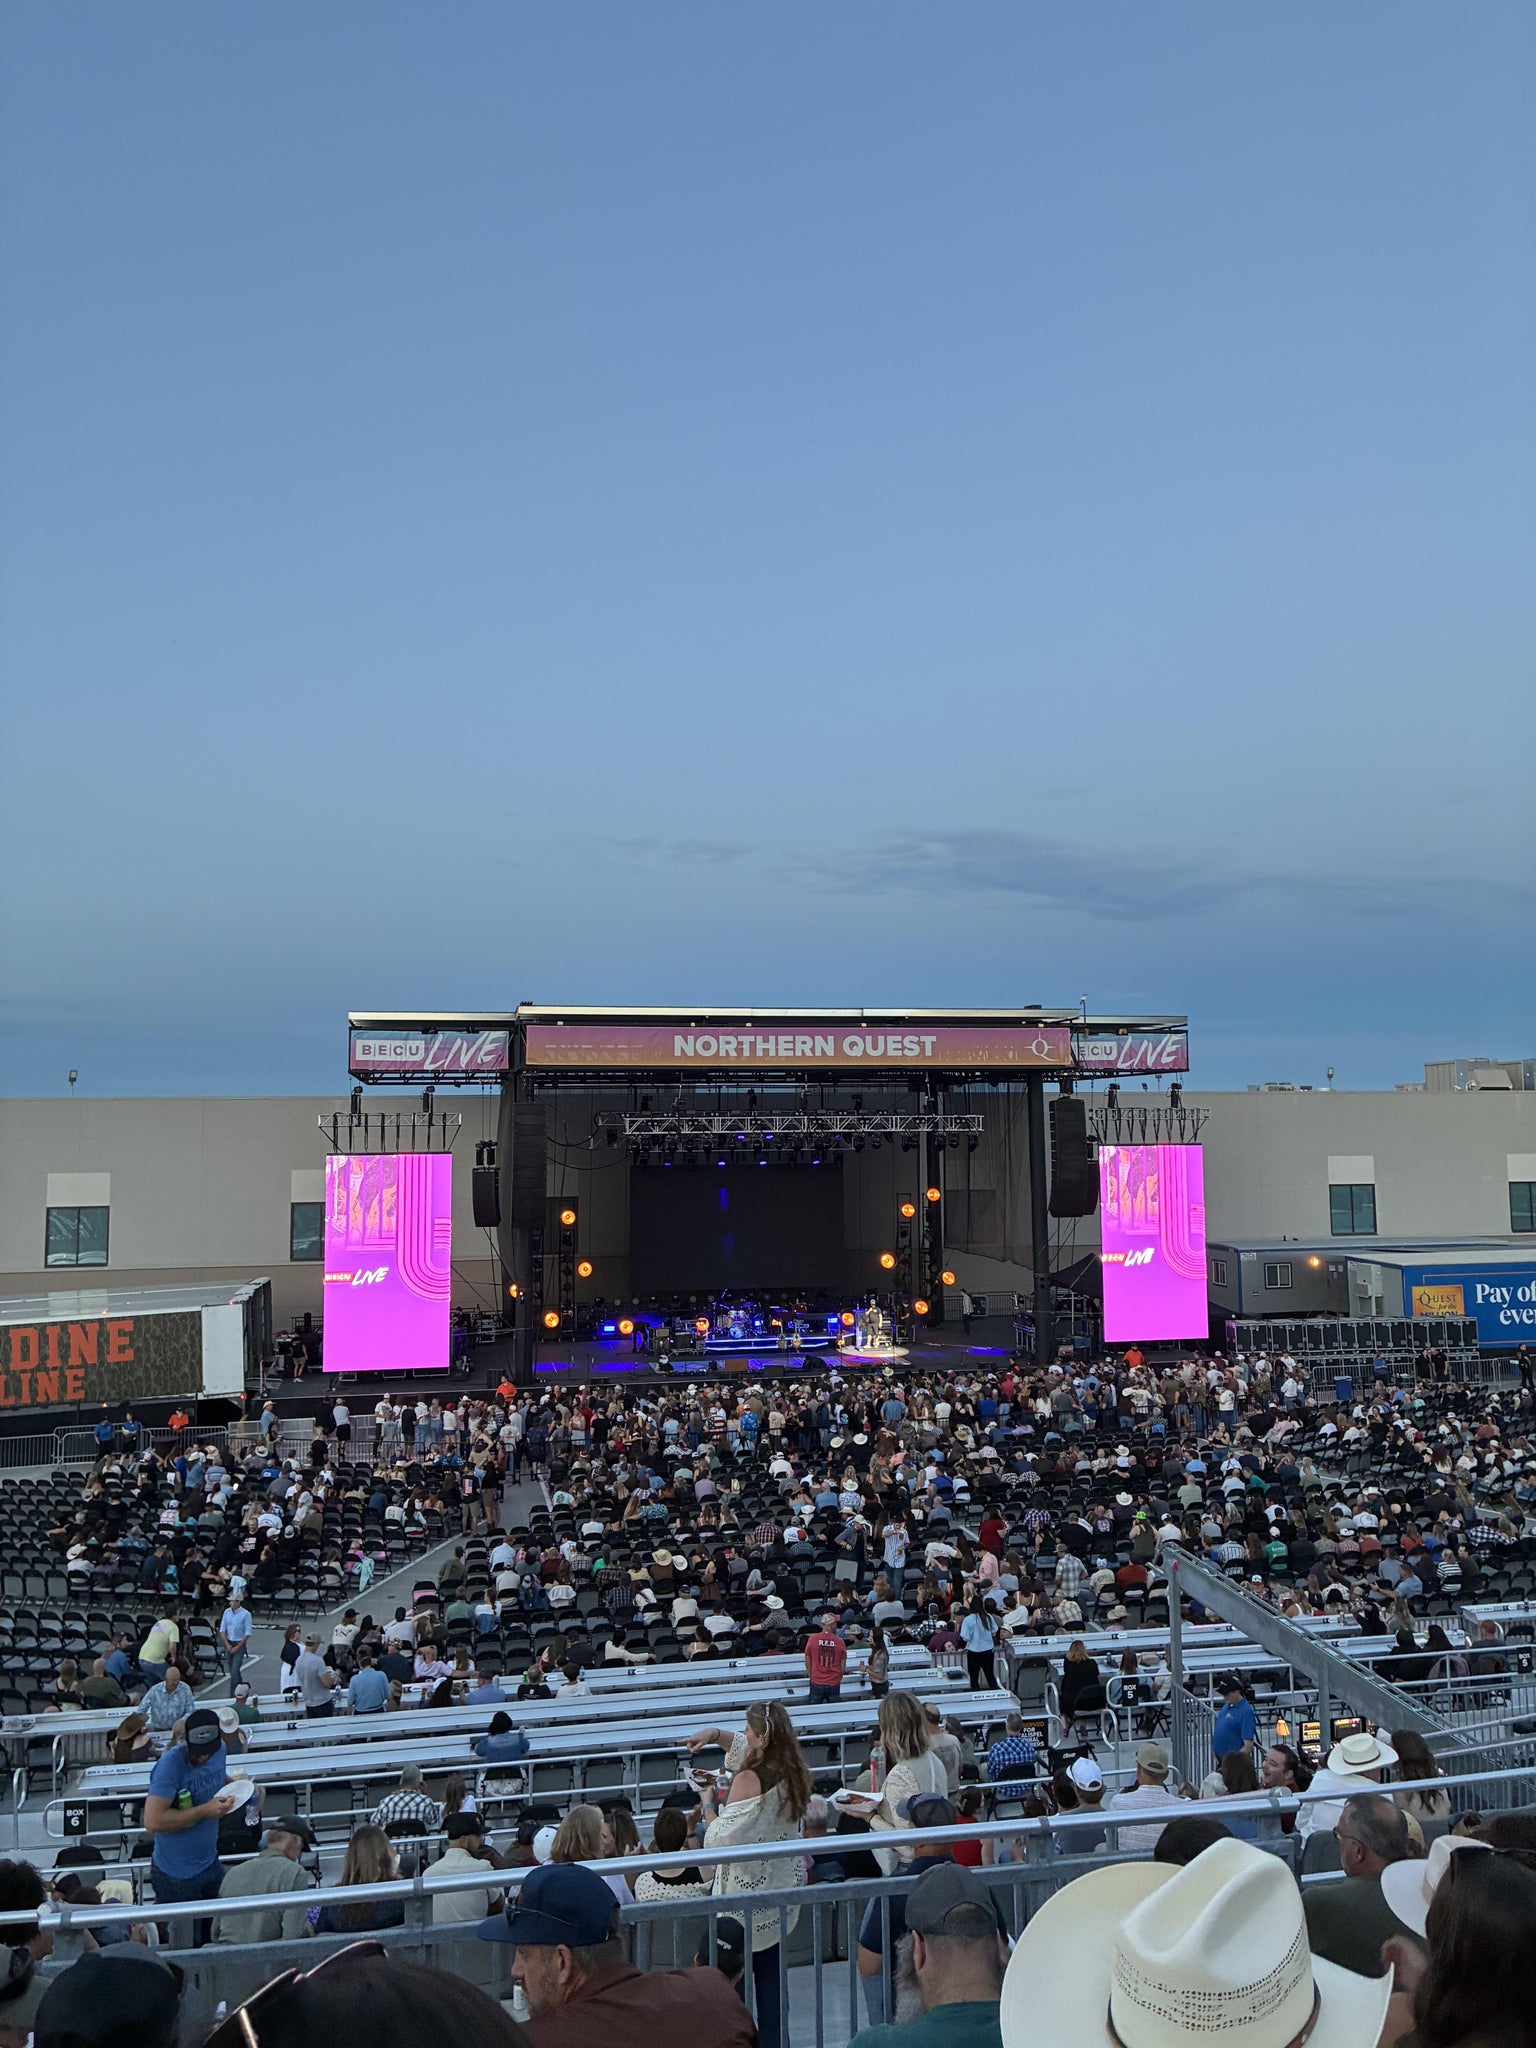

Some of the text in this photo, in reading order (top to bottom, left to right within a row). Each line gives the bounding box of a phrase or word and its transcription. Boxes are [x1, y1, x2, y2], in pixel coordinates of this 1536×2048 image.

[362, 1030, 506, 1070] BECU LIVE
[674, 1035, 835, 1057] NORTHERN
[842, 1035, 937, 1058] QUEST
[1079, 1032, 1185, 1069] ECU LIVE
[351, 1266, 390, 1286] LIVE
[1417, 1290, 1457, 1309] QUEST
[1475, 1283, 1514, 1308] Pay
[1499, 1307, 1536, 1325] eve
[0, 1319, 135, 1371] DINE
[1127, 1691, 1134, 1699] 5
[66, 1808, 85, 1817] BOX
[70, 1816, 80, 1827] 6
